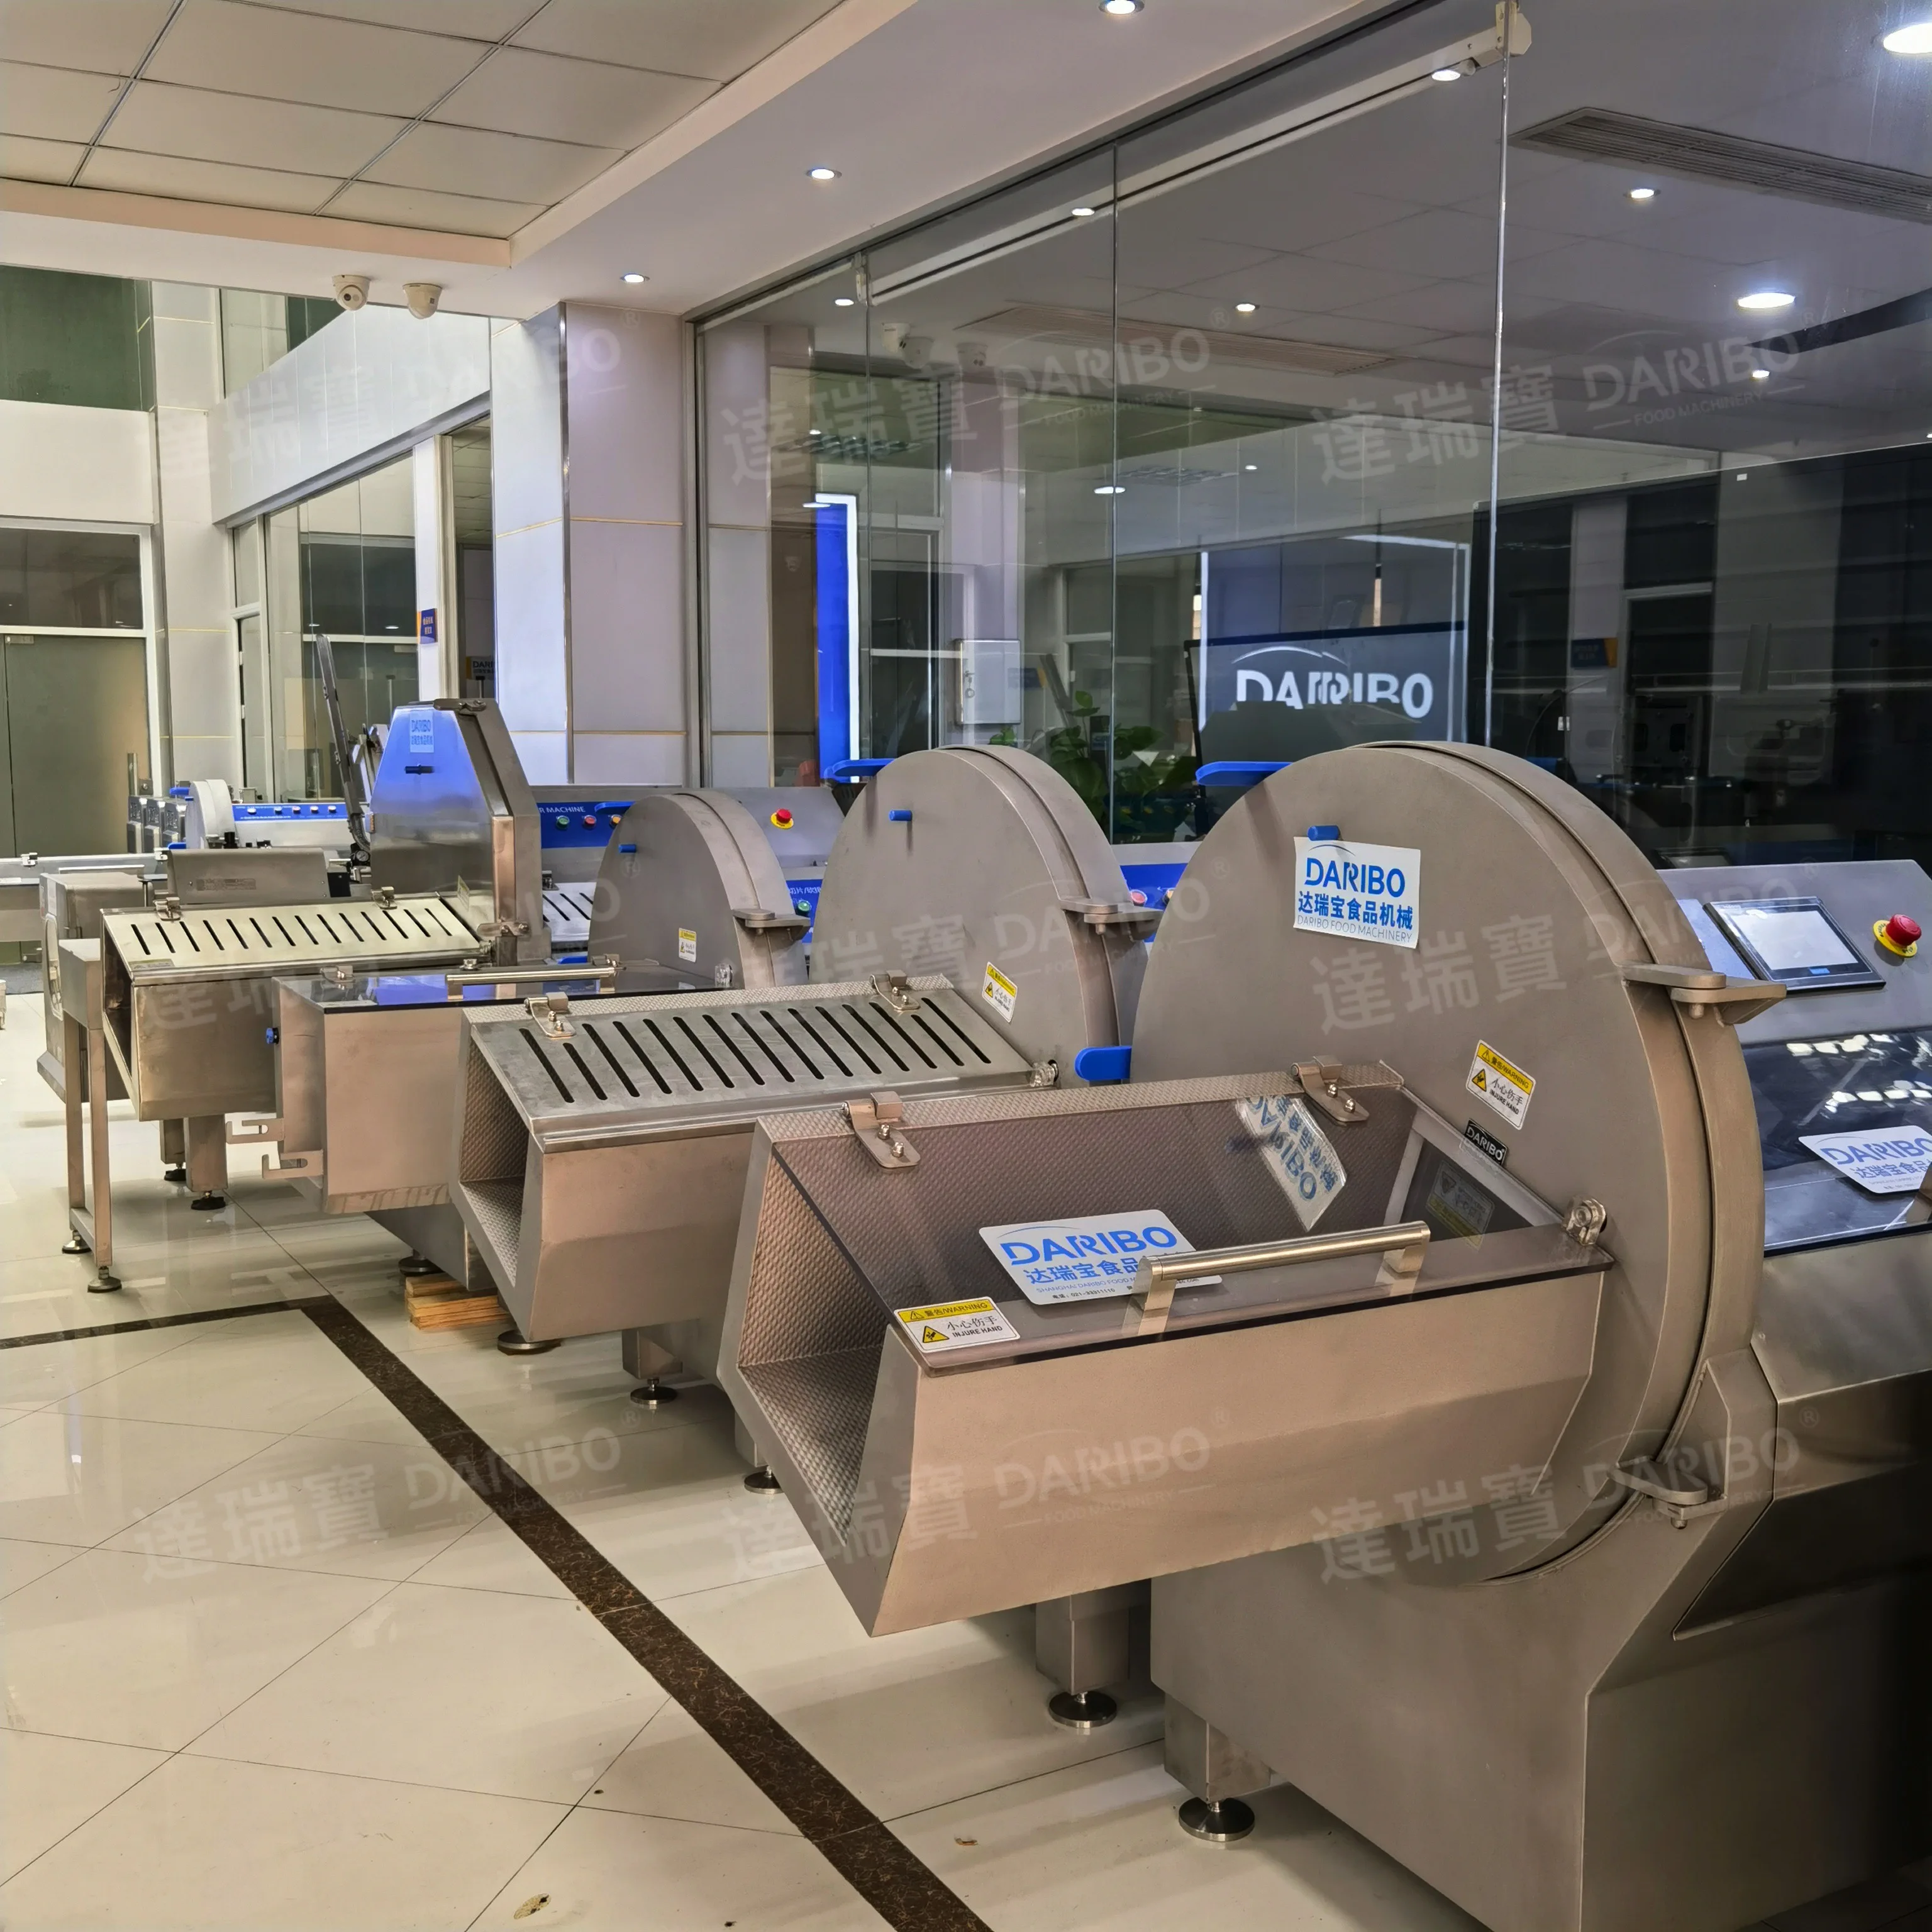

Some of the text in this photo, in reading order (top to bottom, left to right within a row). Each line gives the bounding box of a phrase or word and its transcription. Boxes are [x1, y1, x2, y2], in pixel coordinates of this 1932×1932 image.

[1304, 857, 1405, 897] DARIBO
[1298, 891, 1413, 930] 达瑞宝食品机械
[1297, 915, 1413, 943] DARIBO FOOD MACHINERY
[1490, 1089, 1519, 1114] INJURE HAND
[1491, 1078, 1524, 1106] 小心伤手
[1467, 1128, 1504, 1161] DARIBO
[1820, 1138, 1932, 1165] DARIBO
[1850, 1159, 1931, 1179] 达瑞宝食品
[1000, 1226, 1177, 1266] DARIBO
[1023, 1252, 1180, 1285] 达瑞宝食品
[947, 1316, 997, 1331] 小心伤手
[952, 1326, 1002, 1338] INJURE HAND
